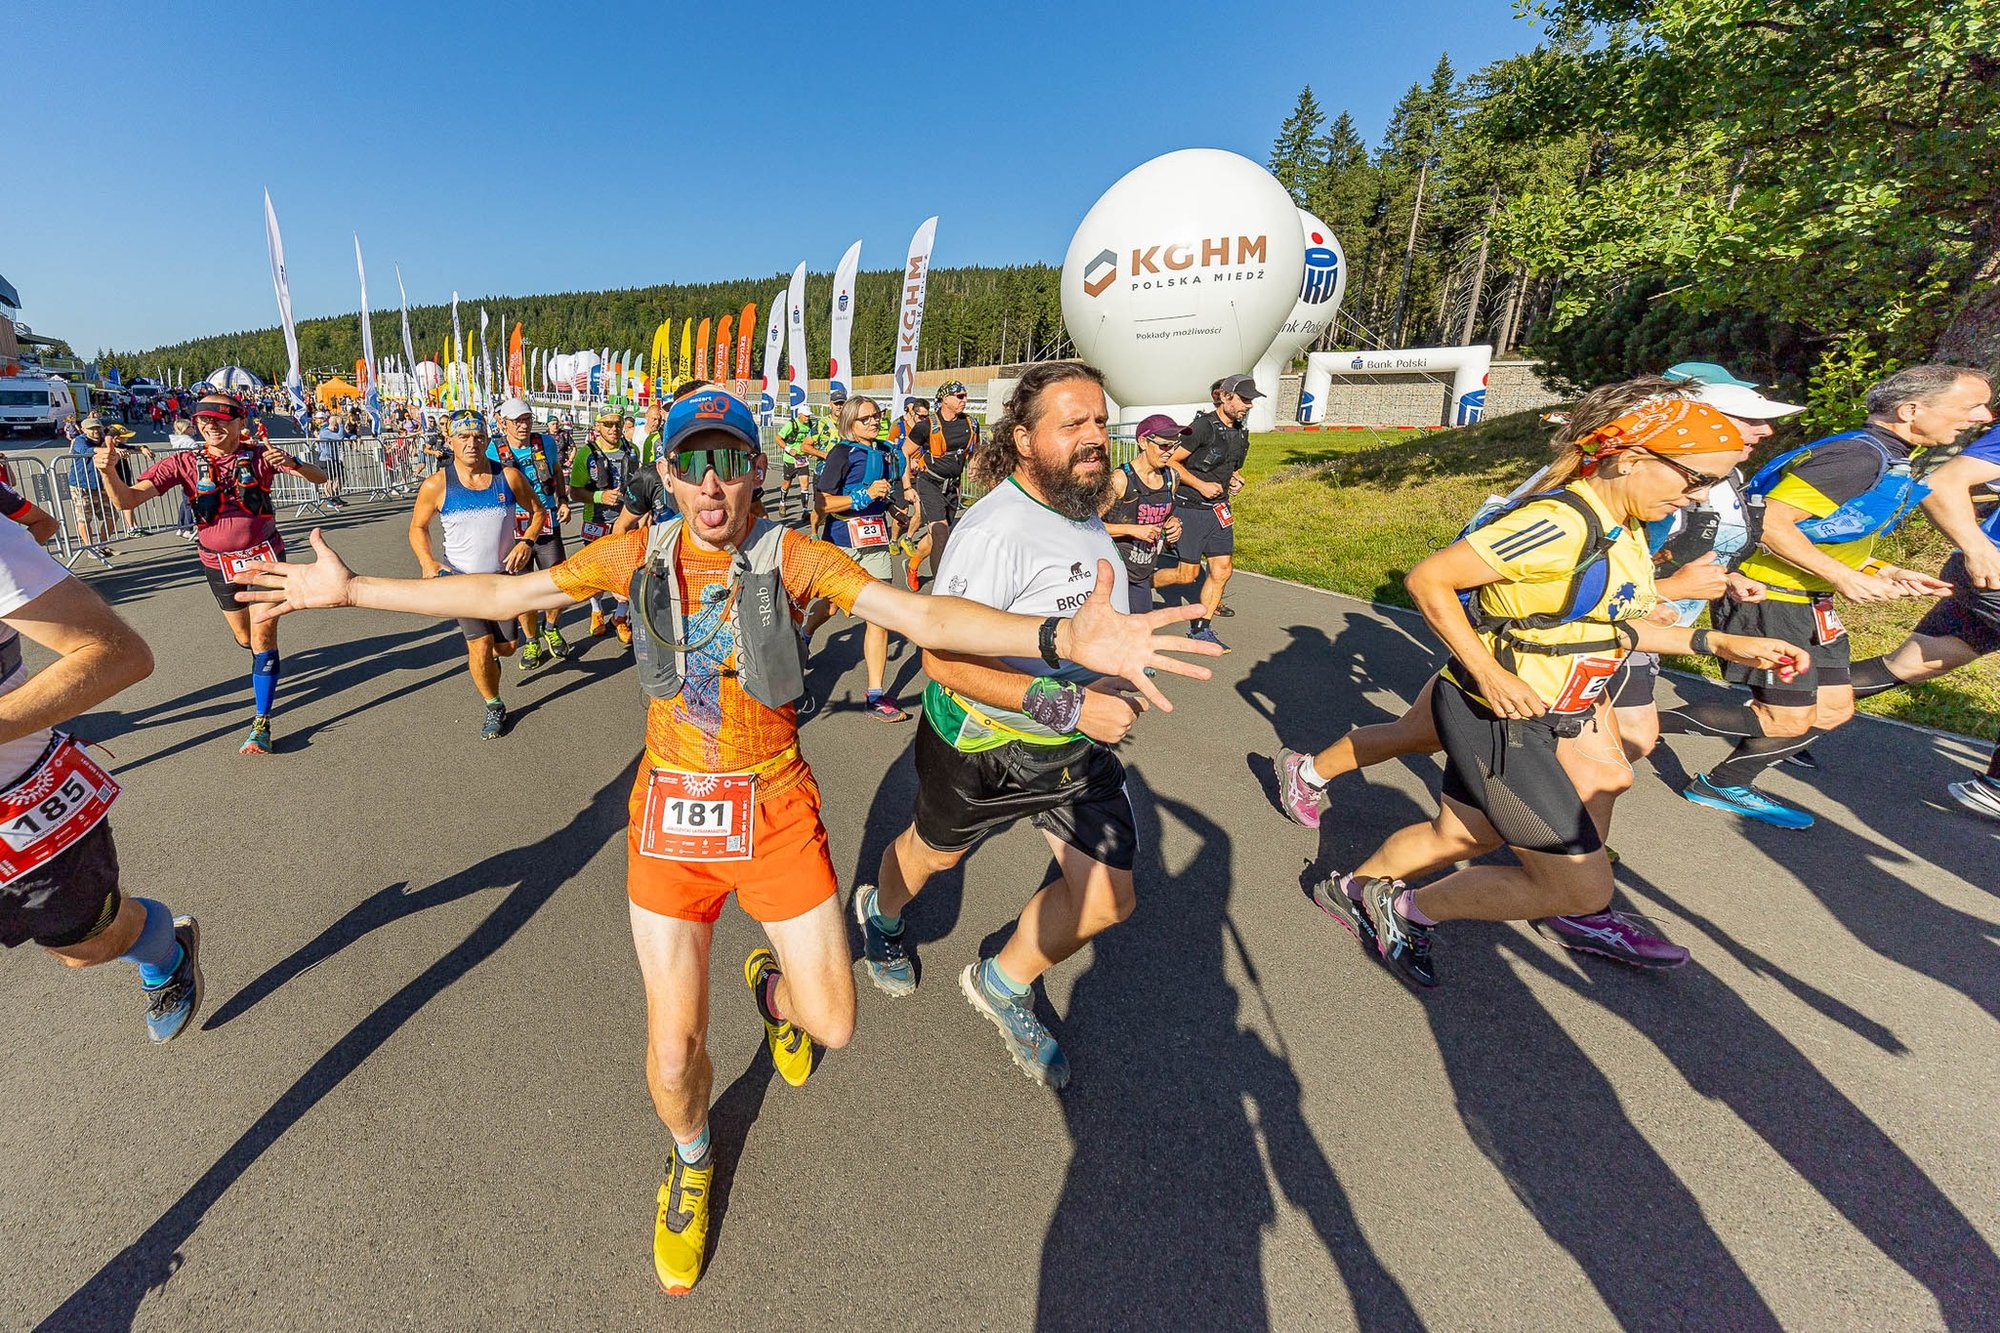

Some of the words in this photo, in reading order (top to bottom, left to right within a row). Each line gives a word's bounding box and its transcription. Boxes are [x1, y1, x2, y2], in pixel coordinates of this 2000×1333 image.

[1132, 235, 1267, 276] KGHM
[1132, 275, 1201, 292] POLSKA
[1213, 269, 1265, 283] MIEDŹ
[901, 255, 923, 352] KGHM
[1136, 332, 1171, 341] Pokłady
[1172, 326, 1222, 337] możliwości
[1280, 319, 1299, 334] nk
[716, 343, 724, 380] Jedynka
[738, 335, 746, 374] Jedynka
[1367, 360, 1393, 369] Bank
[1396, 358, 1427, 368] Polski
[697, 395, 730, 413] 100
[863, 525, 877, 535] 23
[756, 586, 772, 618] Rab
[12, 777, 86, 834] 185
[671, 801, 725, 827] 181
